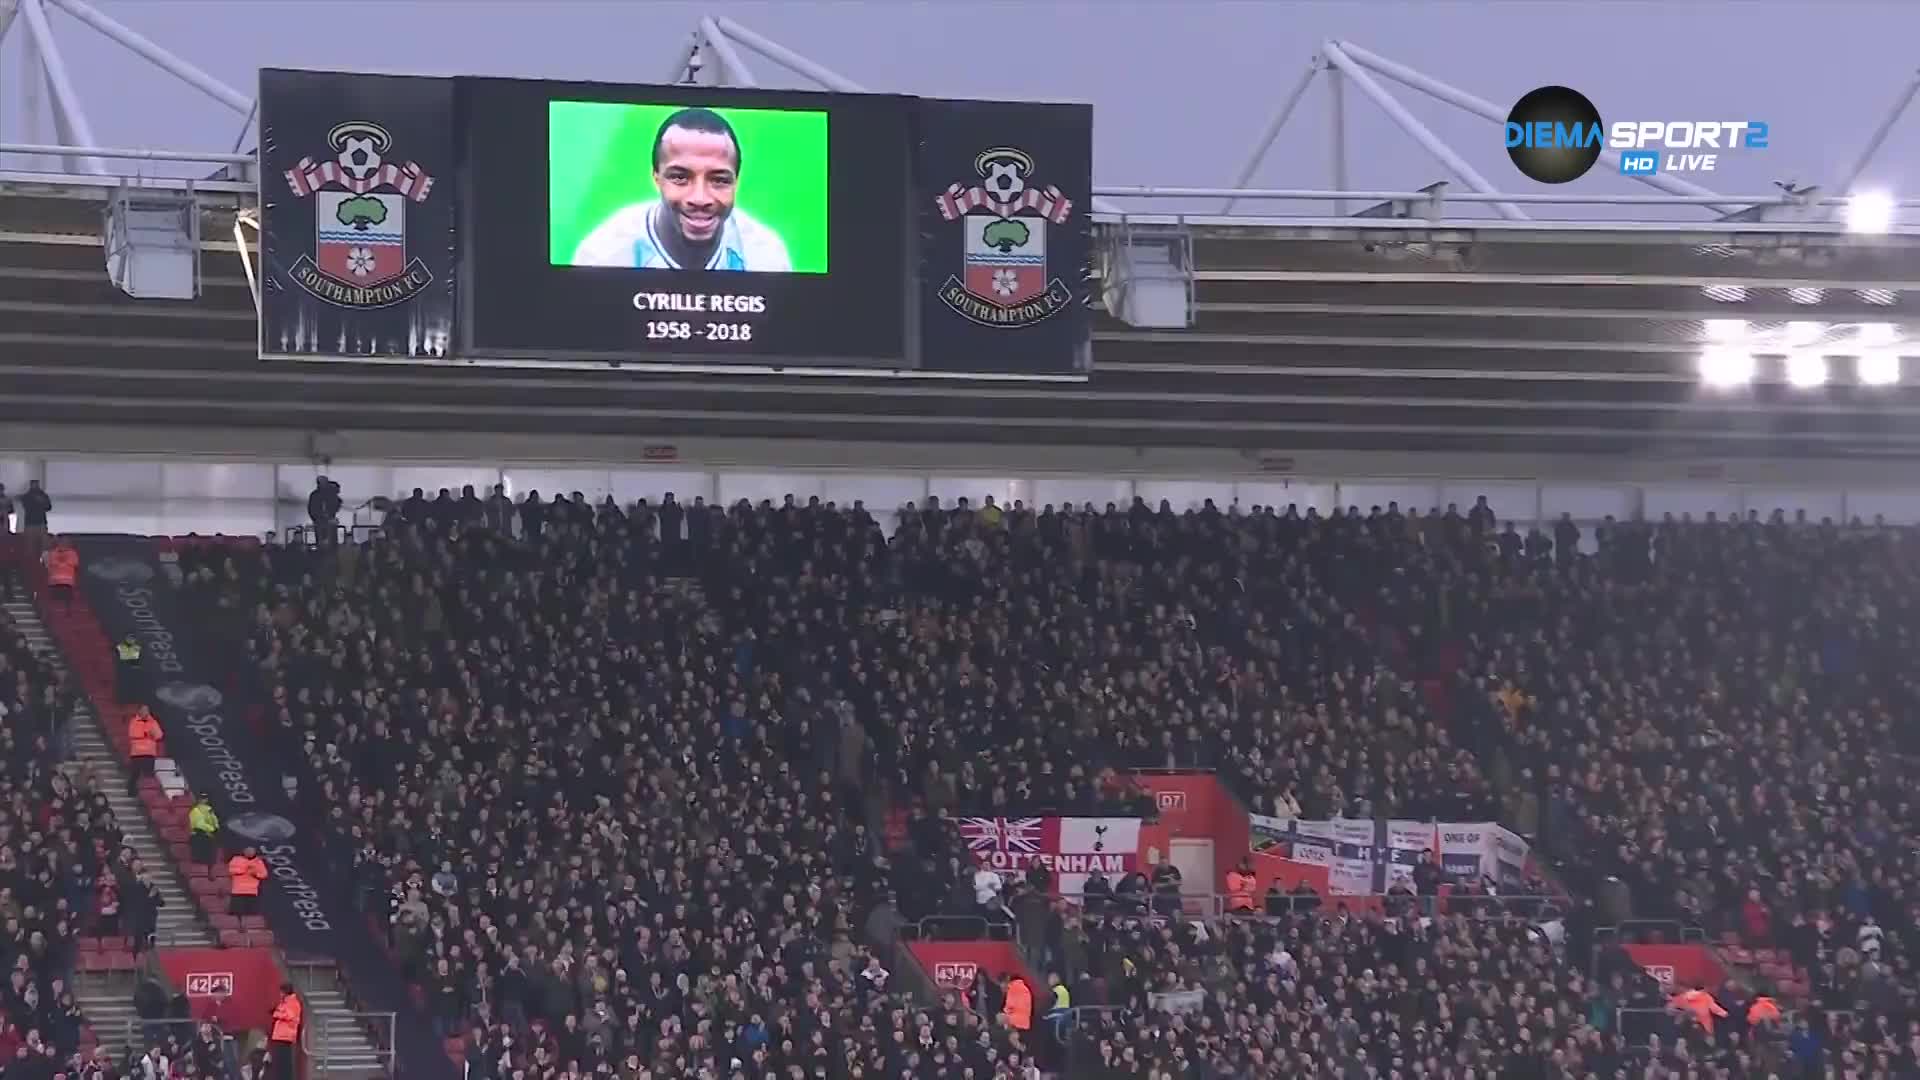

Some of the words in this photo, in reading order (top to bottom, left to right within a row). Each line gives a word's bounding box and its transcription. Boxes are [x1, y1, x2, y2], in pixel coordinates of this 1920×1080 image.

[298, 267, 403, 304] SOUTHAMPTON
[403, 271, 424, 291] FC
[633, 291, 706, 311] CYRILLE
[711, 294, 767, 312] REGIS
[947, 287, 1044, 322] SOUTHAMPTON
[1044, 290, 1062, 309] FC
[647, 321, 692, 339] 1958
[706, 323, 751, 341] 2018
[119, 584, 183, 673] SportPesa
[187, 714, 256, 805] SportPesa
[1162, 795, 1180, 809] D7
[190, 977, 208, 992] 42
